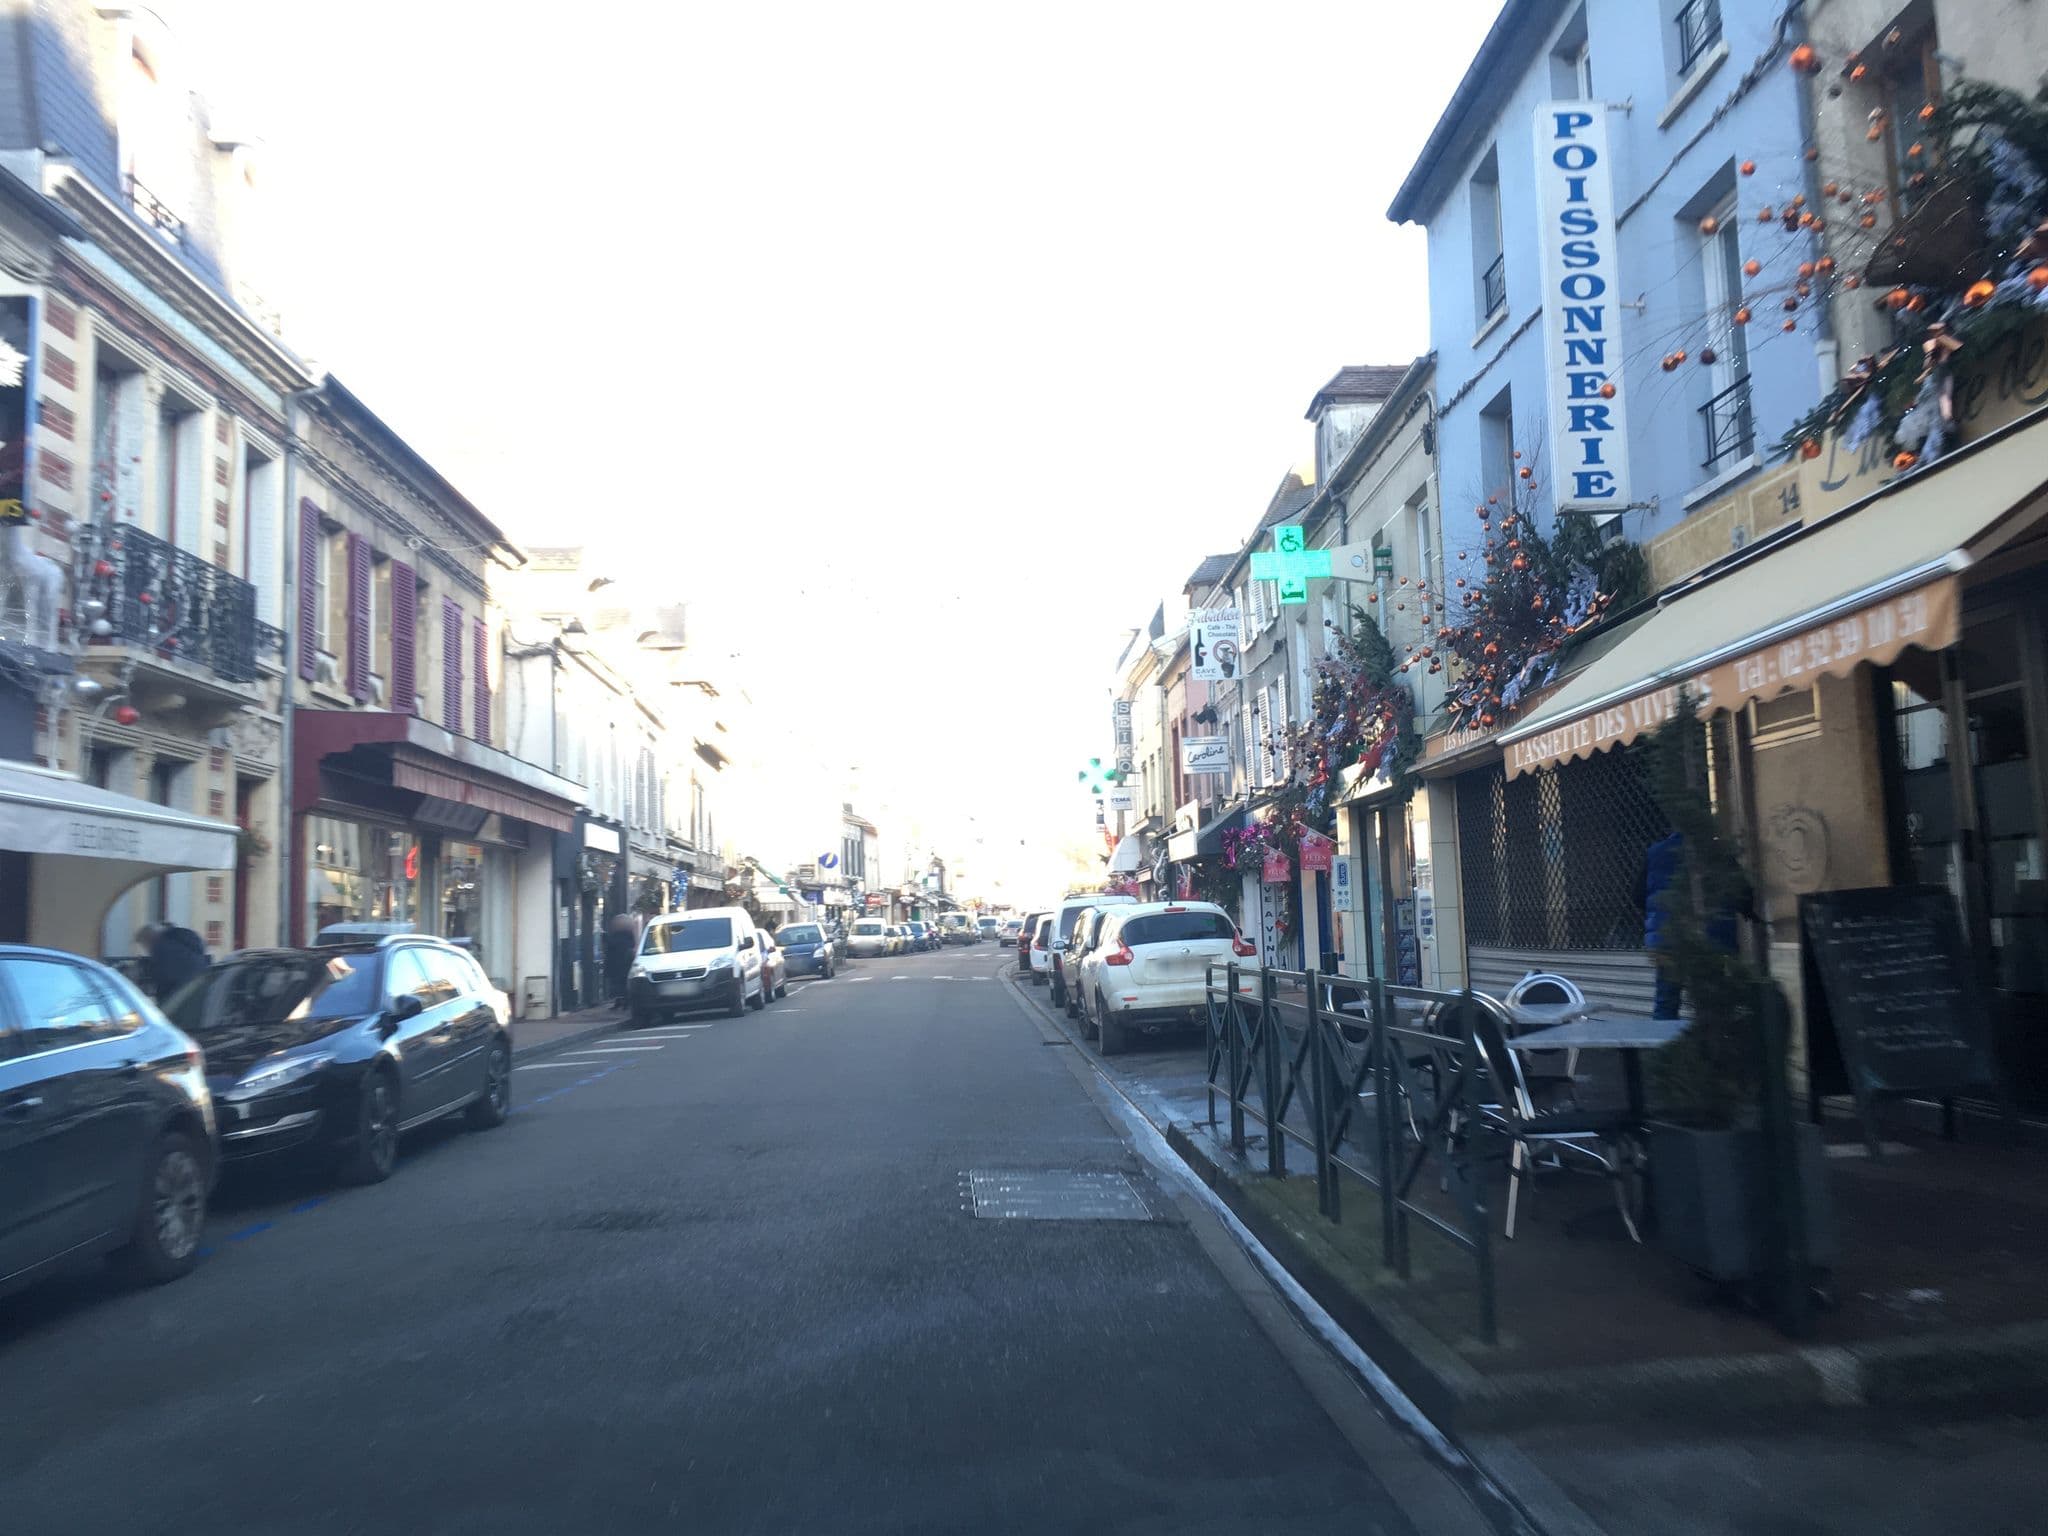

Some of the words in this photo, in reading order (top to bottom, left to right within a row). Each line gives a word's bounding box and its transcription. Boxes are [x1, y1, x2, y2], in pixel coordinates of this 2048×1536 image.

[1552, 111, 1618, 500] POISSONNERIE
[1119, 702, 1132, 773] SEIKO
[1187, 745, 1225, 763] Caroline
[1513, 716, 1591, 769] L'ASSIETTE
[1594, 703, 1626, 741] DES
